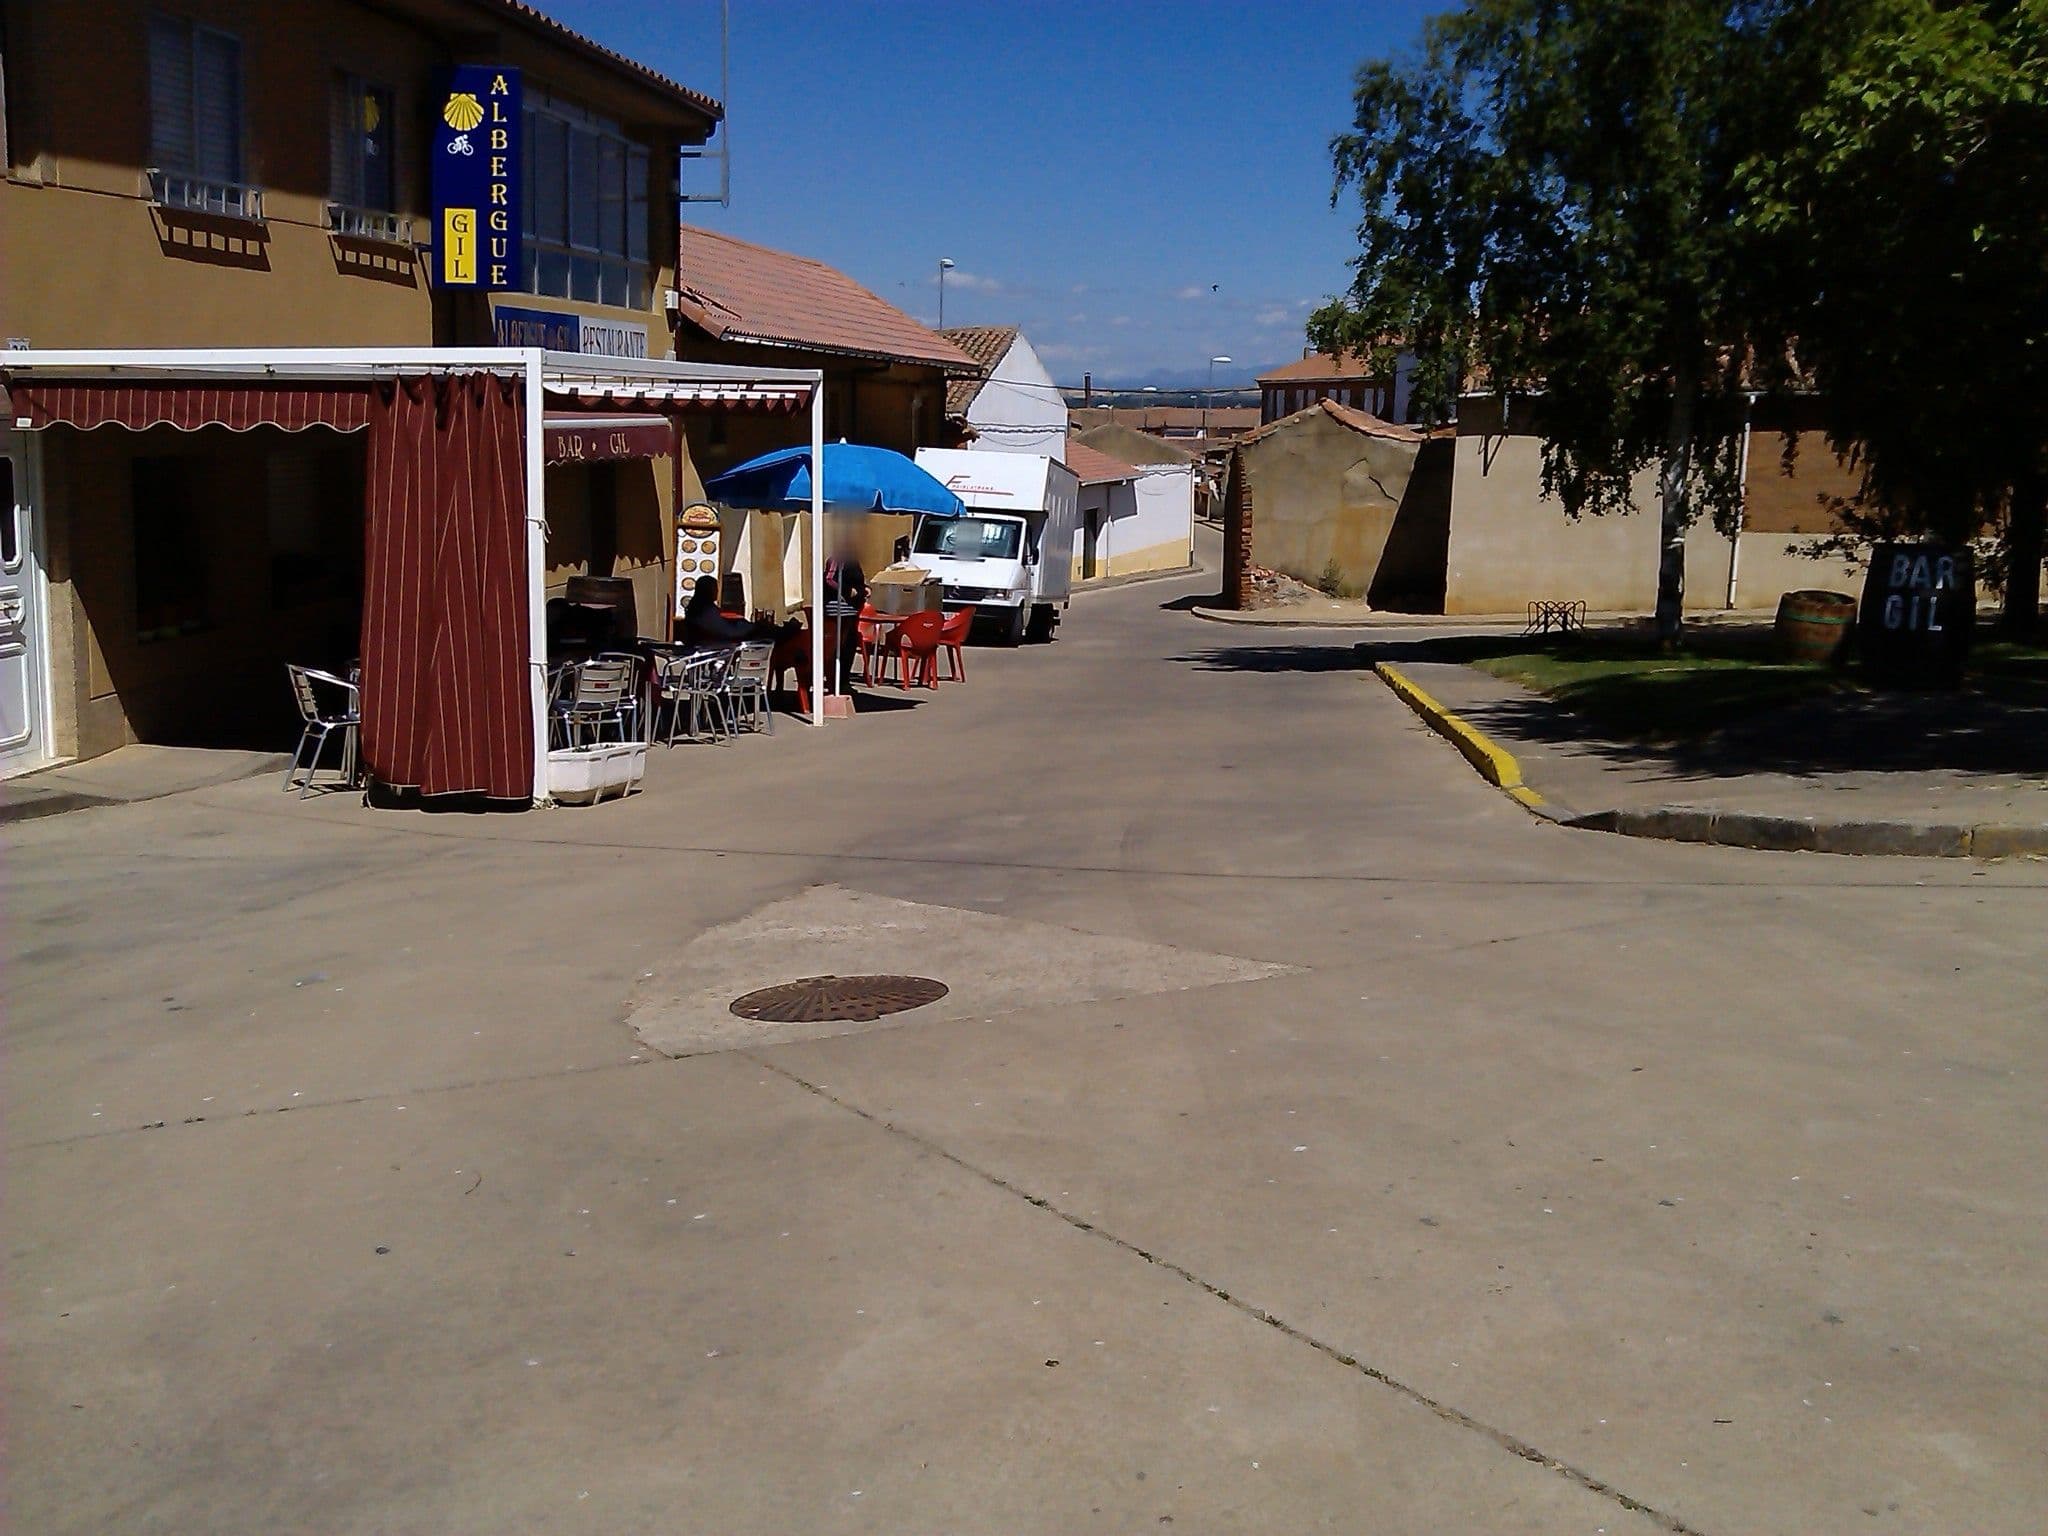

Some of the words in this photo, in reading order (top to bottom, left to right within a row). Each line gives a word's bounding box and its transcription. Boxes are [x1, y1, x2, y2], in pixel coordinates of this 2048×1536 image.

[490, 75, 509, 285] ALBERGUE
[451, 213, 468, 279] GIL
[558, 435, 585, 459] BAR
[609, 433, 630, 455] GIL
[1887, 553, 1955, 589] BAR
[1883, 595, 1943, 632] GIL
